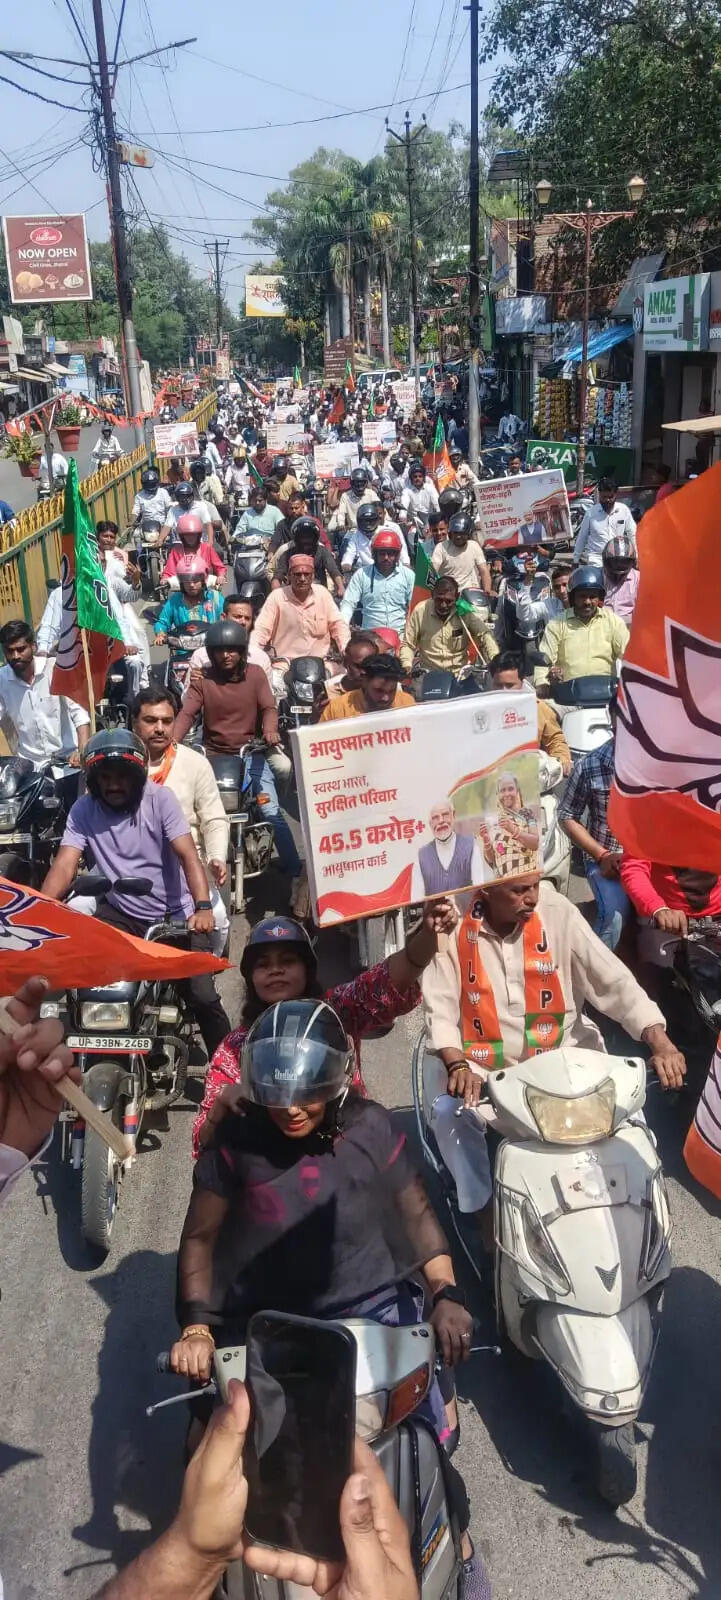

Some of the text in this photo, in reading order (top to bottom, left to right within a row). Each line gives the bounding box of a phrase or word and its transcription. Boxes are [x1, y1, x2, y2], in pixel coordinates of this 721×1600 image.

[18, 247, 78, 259] NOW OPEN
[647, 288, 677, 316] AMAZE
[309, 726, 412, 760] आयुष्मान भारत
[312, 779, 341, 795] स्वस्थ
[315, 788, 398, 819] सुरक्षित परिवार
[319, 831, 362, 855] 45.5
[322, 851, 388, 880] आयुष्मान कार्ड
